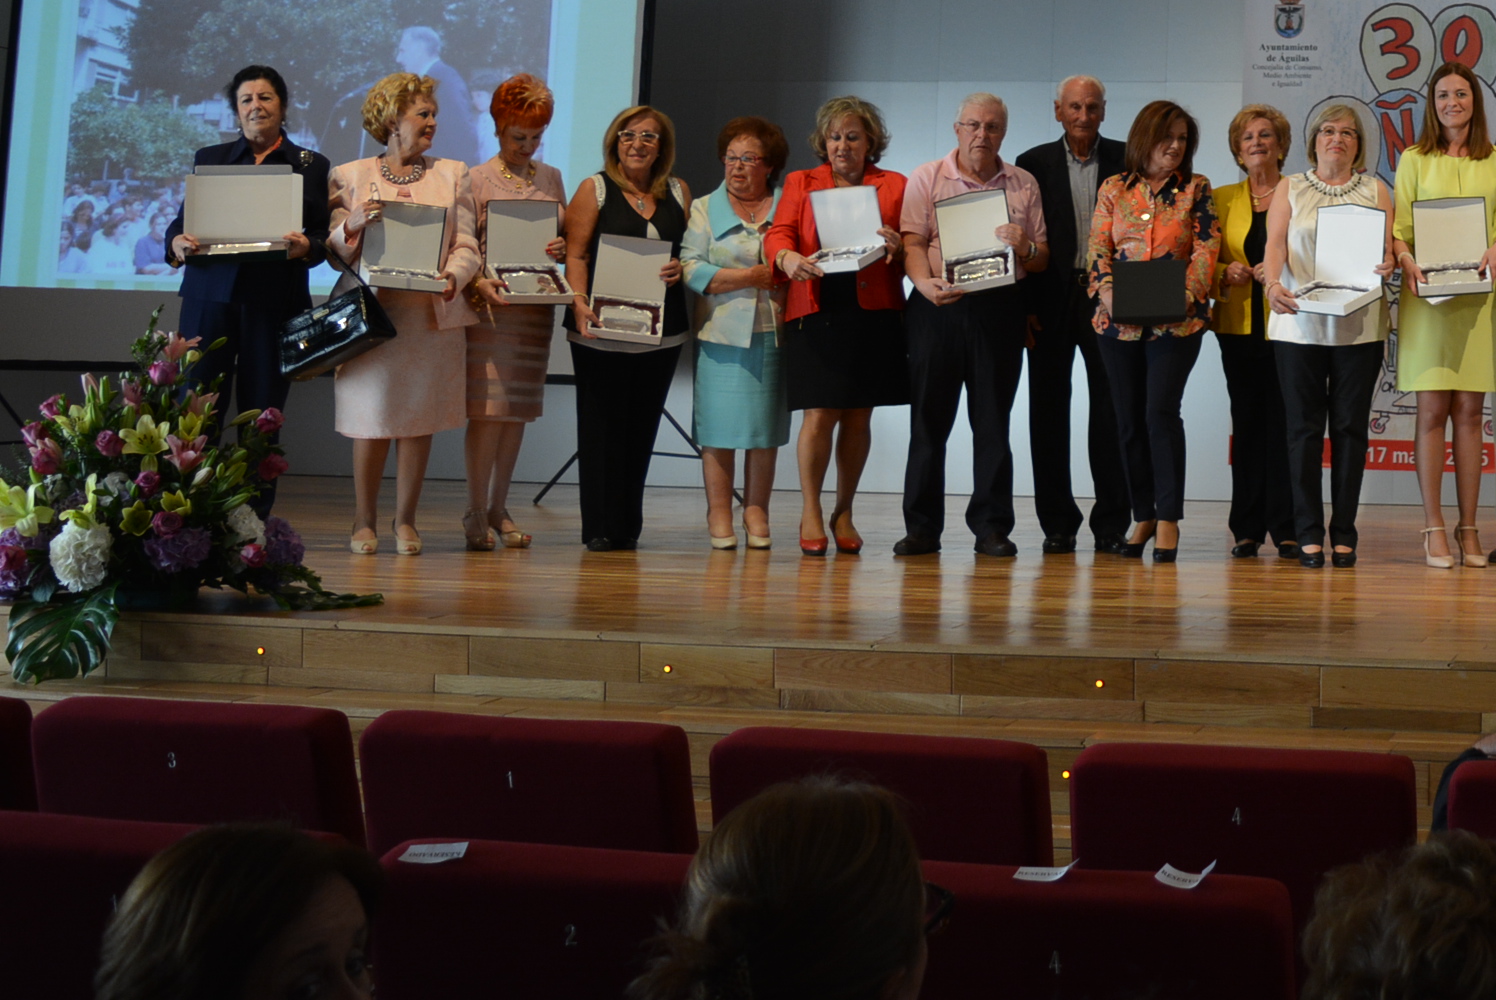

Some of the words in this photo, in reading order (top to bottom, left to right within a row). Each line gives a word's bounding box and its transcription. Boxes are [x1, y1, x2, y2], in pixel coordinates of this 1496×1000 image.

[1259, 43, 1318, 53] Ayuntamiento
[1266, 54, 1276, 62] de
[1279, 52, 1310, 63] Águilas
[1367, 446, 1387, 464] 17
[167, 751, 178, 769] 3
[505, 770, 515, 789] 1
[1231, 806, 1242, 826] 4
[564, 922, 579, 948] 2
[1048, 949, 1062, 976] 4
